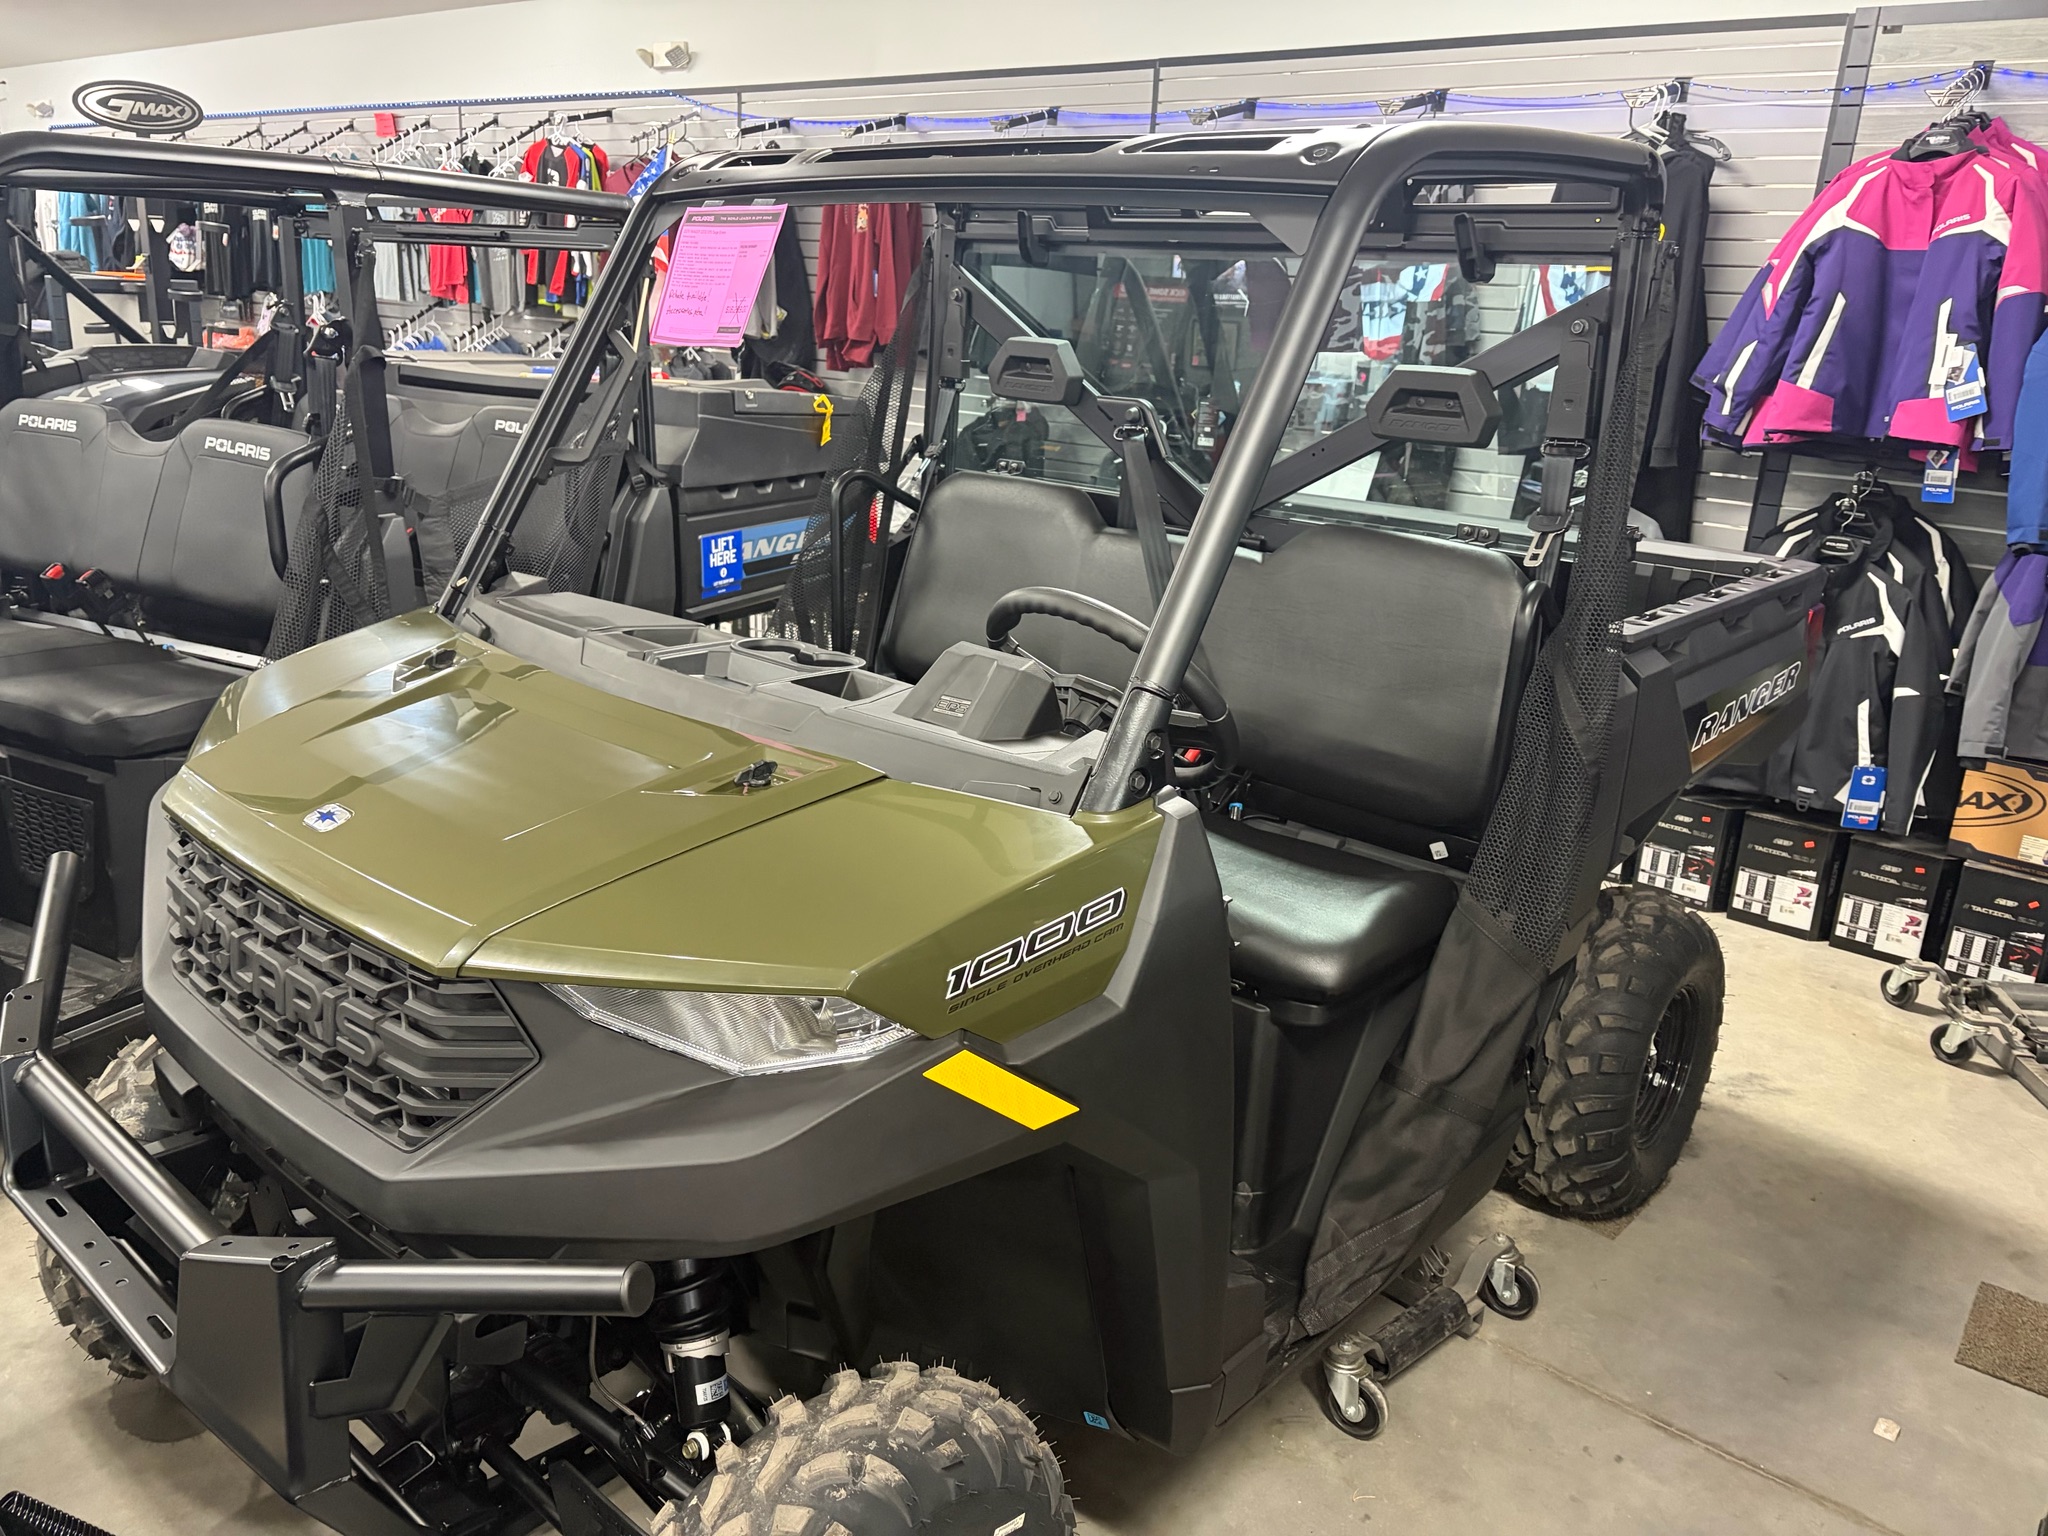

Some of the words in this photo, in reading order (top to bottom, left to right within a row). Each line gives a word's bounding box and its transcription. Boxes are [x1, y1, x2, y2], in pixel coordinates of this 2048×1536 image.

[1951, 398, 1981, 411] POLARIS
[19, 413, 77, 432] POLARIS
[204, 436, 271, 461] POLARIS
[711, 535, 734, 553] LIFT
[709, 549, 737, 568] HERE
[1837, 616, 1876, 635] POLARIS
[935, 700, 971, 715] EPS
[1690, 660, 1802, 752] RANGER
[1658, 821, 1692, 834] TACTICAL
[1754, 844, 1791, 859] TACTICAL
[1859, 870, 1900, 885] TACTICAL
[1971, 904, 2016, 921] TACTICAL
[945, 887, 1129, 1000] 1000
[167, 867, 386, 1068] POLARIS
[947, 980, 1008, 1014] SINGLE
[1013, 941, 1090, 984] OVERHEAD
[1094, 922, 1125, 944] CAM
